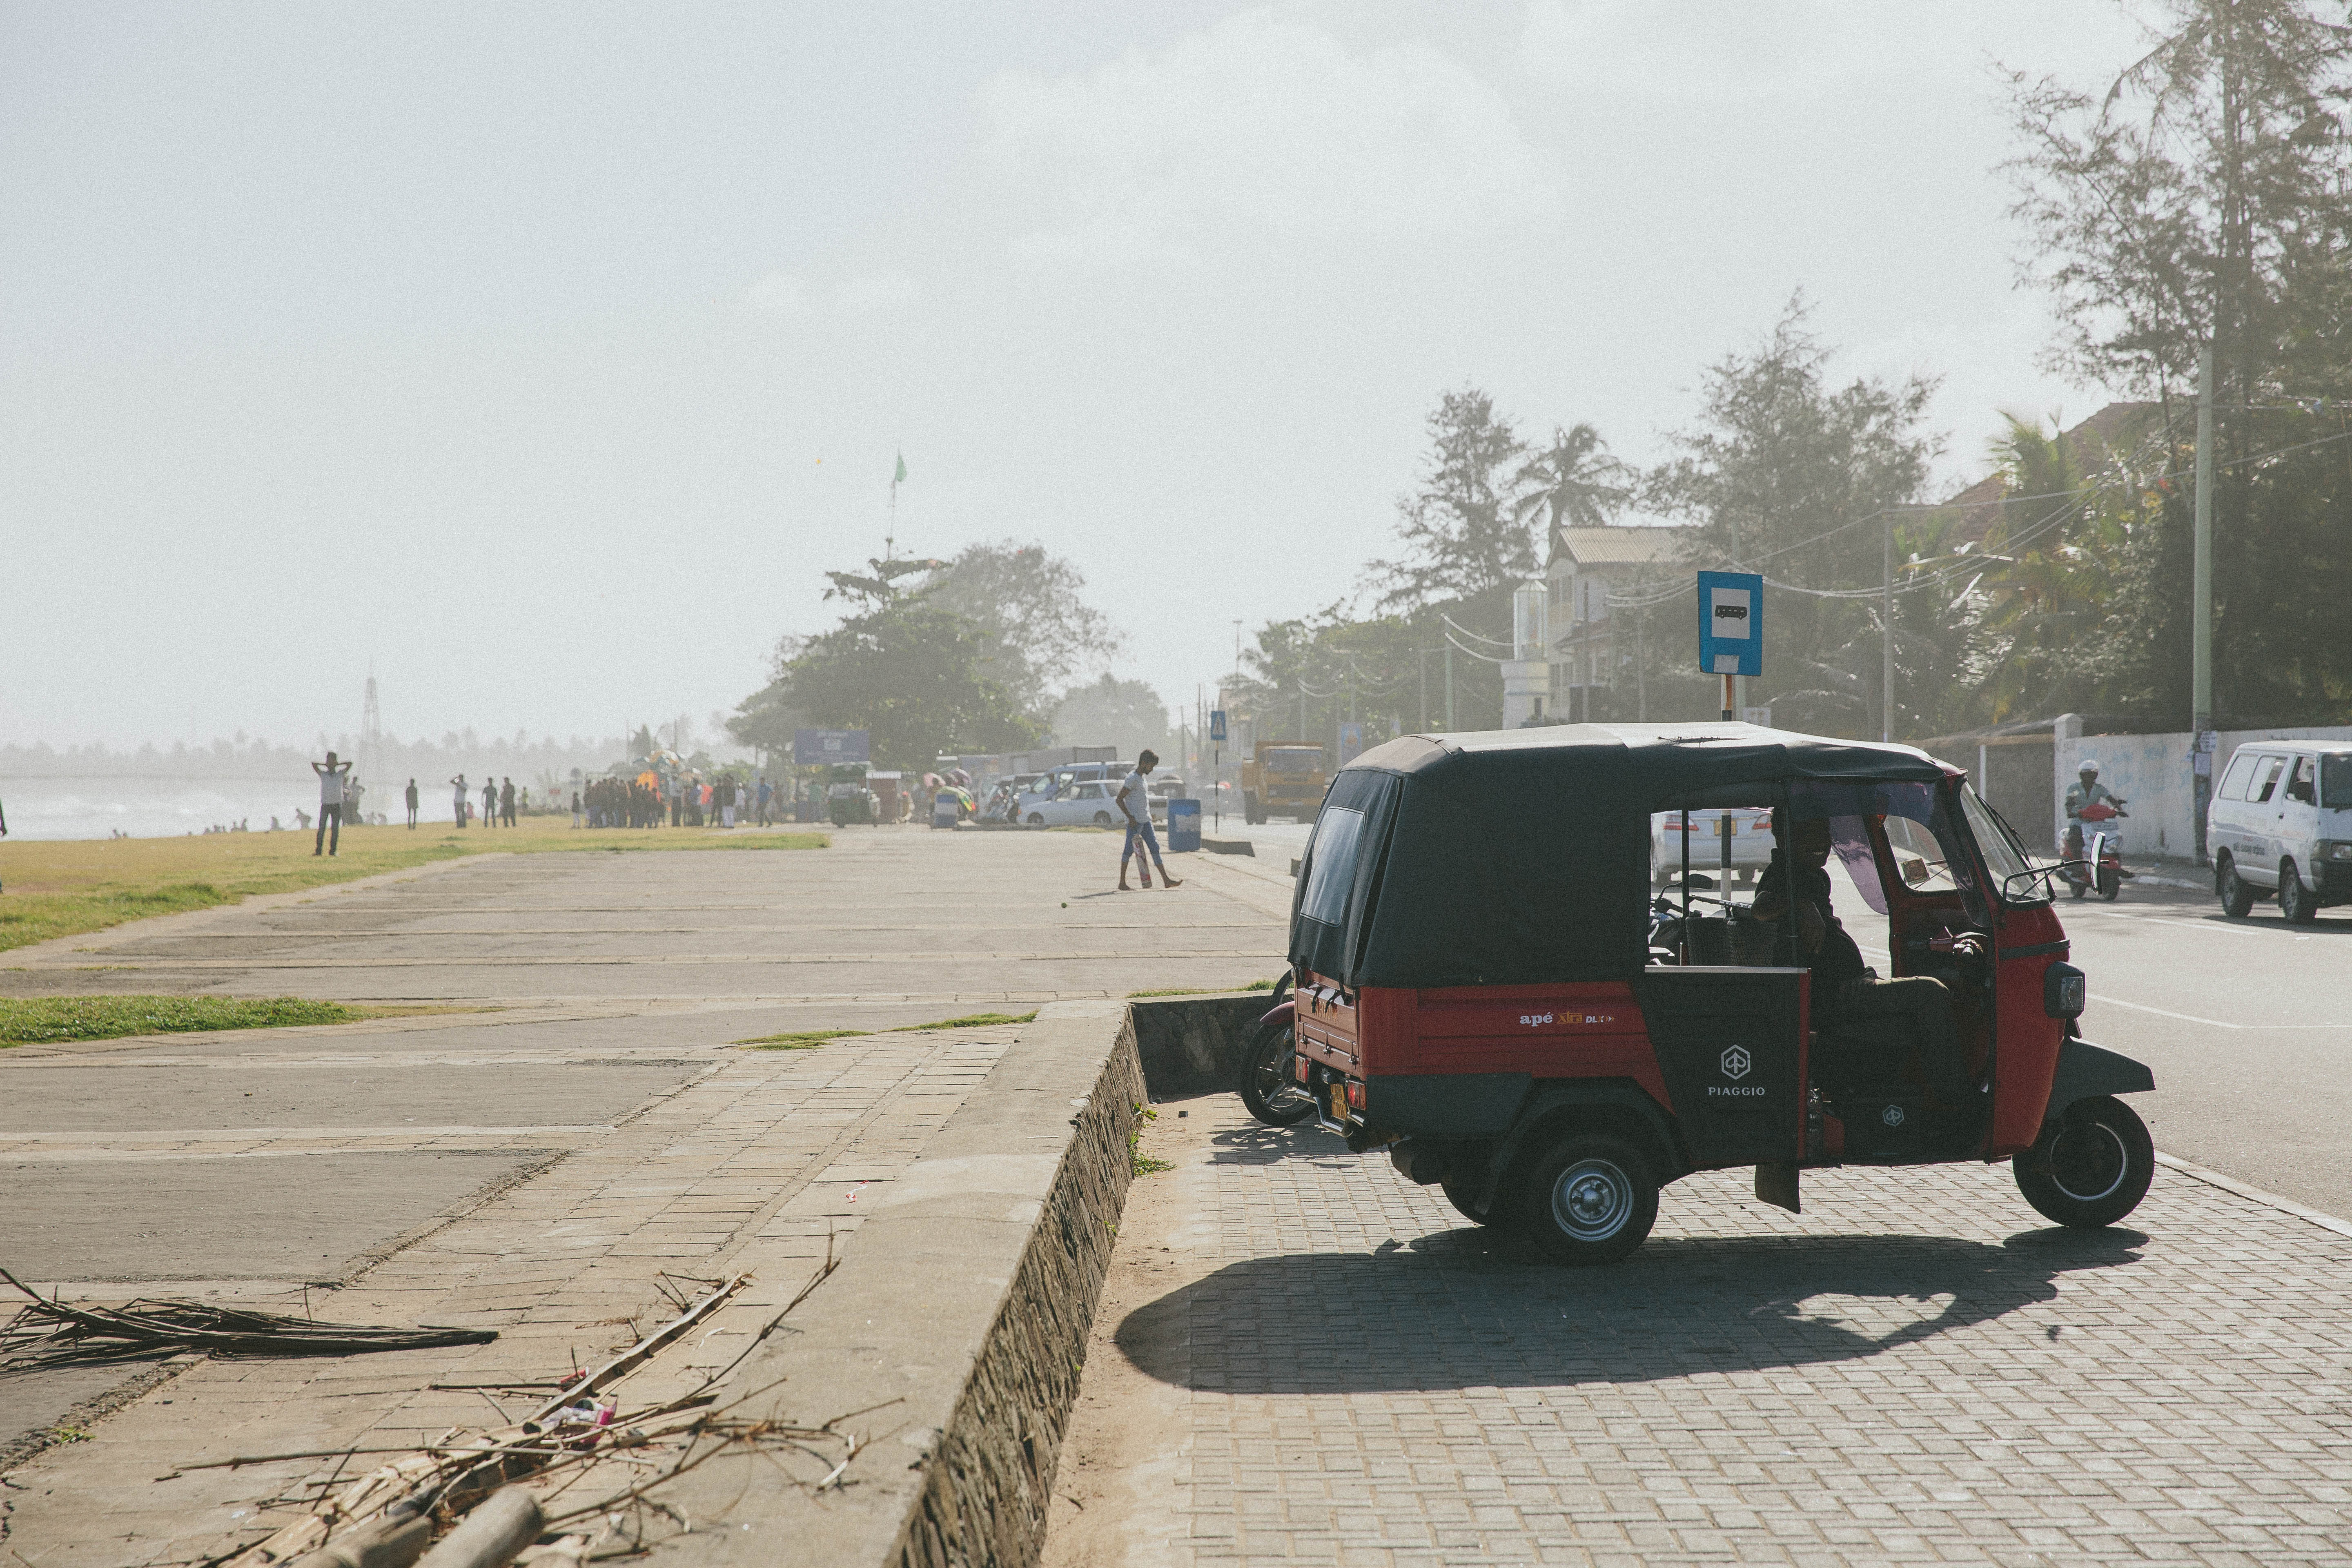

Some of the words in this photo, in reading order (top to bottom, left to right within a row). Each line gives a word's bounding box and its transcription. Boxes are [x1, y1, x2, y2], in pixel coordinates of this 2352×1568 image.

[1520, 1012, 1553, 1027] apé
[1557, 1011, 1583, 1024] xtra
[1708, 1087, 1765, 1096] PIAGGIO
